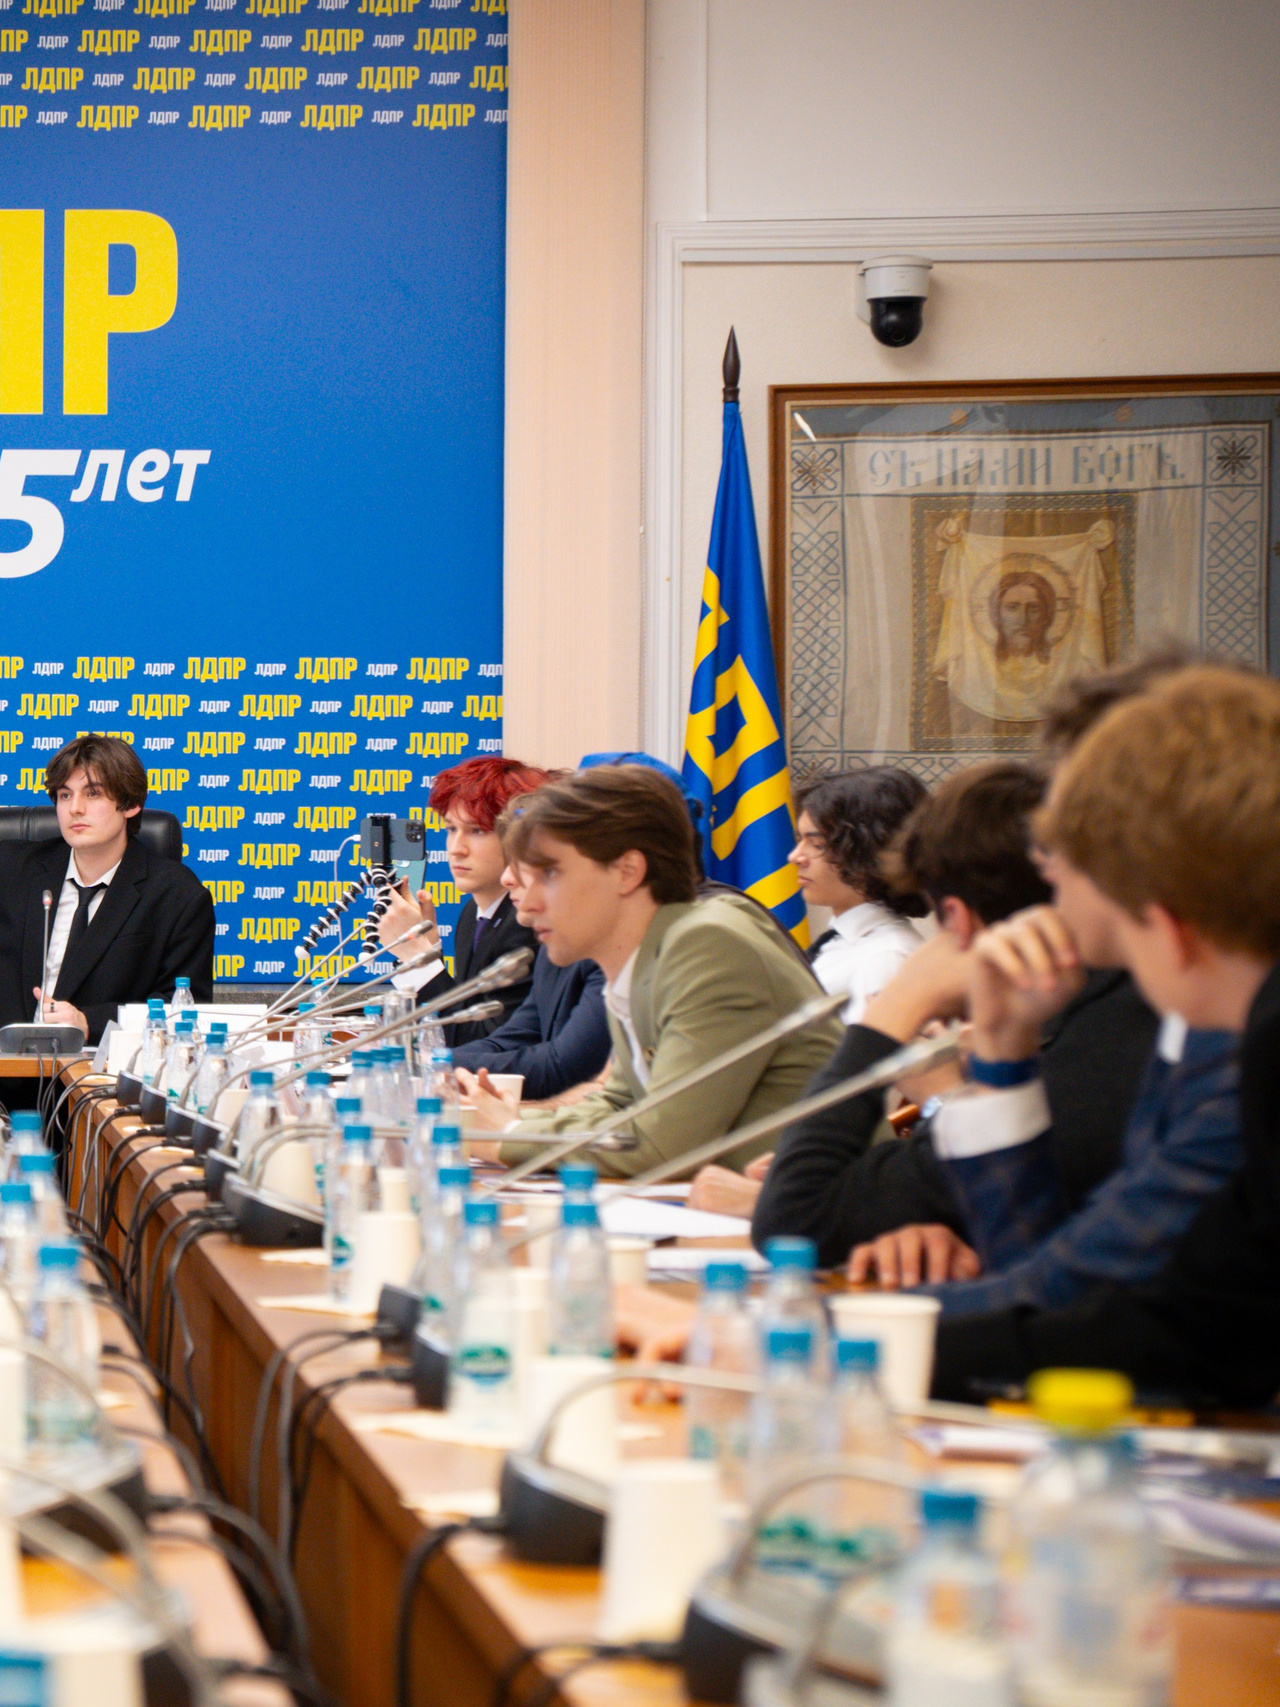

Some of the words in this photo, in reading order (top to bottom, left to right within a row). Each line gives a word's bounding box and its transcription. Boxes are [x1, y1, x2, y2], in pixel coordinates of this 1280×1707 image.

[37, 36, 68, 49] ЛДПР
[78, 30, 140, 56] ЛДПР
[149, 36, 180, 49] ЛДПР
[189, 29, 252, 55] ЛДПР
[261, 35, 292, 49] ЛДПР
[301, 29, 364, 55] ЛДПР
[373, 35, 404, 48] ЛДПР
[414, 28, 476, 54] ЛДПР
[36, 111, 68, 125] ЛДПР
[77, 105, 139, 131] ЛДПР
[148, 111, 179, 125] ЛДПР
[188, 105, 251, 131] ЛДПР
[260, 111, 291, 125] ЛДПР
[300, 105, 363, 131] ЛДПР
[372, 111, 403, 124] ЛДПР
[412, 104, 475, 130] ЛДПР
[70, 448, 211, 502] лет
[32, 663, 64, 676] ЛДПР
[73, 657, 135, 682] ЛДПР
[144, 663, 175, 676] ЛДПР
[184, 657, 246, 683] ЛДПР
[255, 664, 286, 676] ЛДПР
[295, 657, 357, 683] ЛДПР
[366, 664, 398, 677] ЛДПР
[406, 658, 469, 683] ЛДПР
[17, 694, 79, 719] ЛДПР
[128, 694, 190, 720] ЛДПР
[239, 695, 301, 720] ЛДПР
[350, 695, 413, 720] ЛДПР
[32, 737, 64, 750] ЛДПР
[143, 738, 174, 751] ЛДПР
[183, 732, 245, 757] ЛДПР
[254, 738, 286, 751] ЛДПР
[294, 732, 357, 758] ЛДПР
[365, 739, 397, 751] ЛДПР
[406, 732, 469, 758] ЛДПР
[198, 775, 230, 788] ЛДПР
[238, 769, 301, 794] ЛДПР
[309, 776, 341, 788] ЛДПР
[349, 769, 412, 795] ЛДПР
[182, 806, 245, 832] ЛДПР
[254, 813, 285, 825] ЛДПР
[294, 807, 356, 832] ЛДПР
[198, 850, 229, 862] ЛДПР
[238, 843, 300, 869] ЛДПР
[309, 850, 341, 863] ЛДПР
[253, 887, 285, 900] ЛДПР
[238, 918, 300, 943] ЛДПР
[253, 961, 285, 974] ЛДПР
